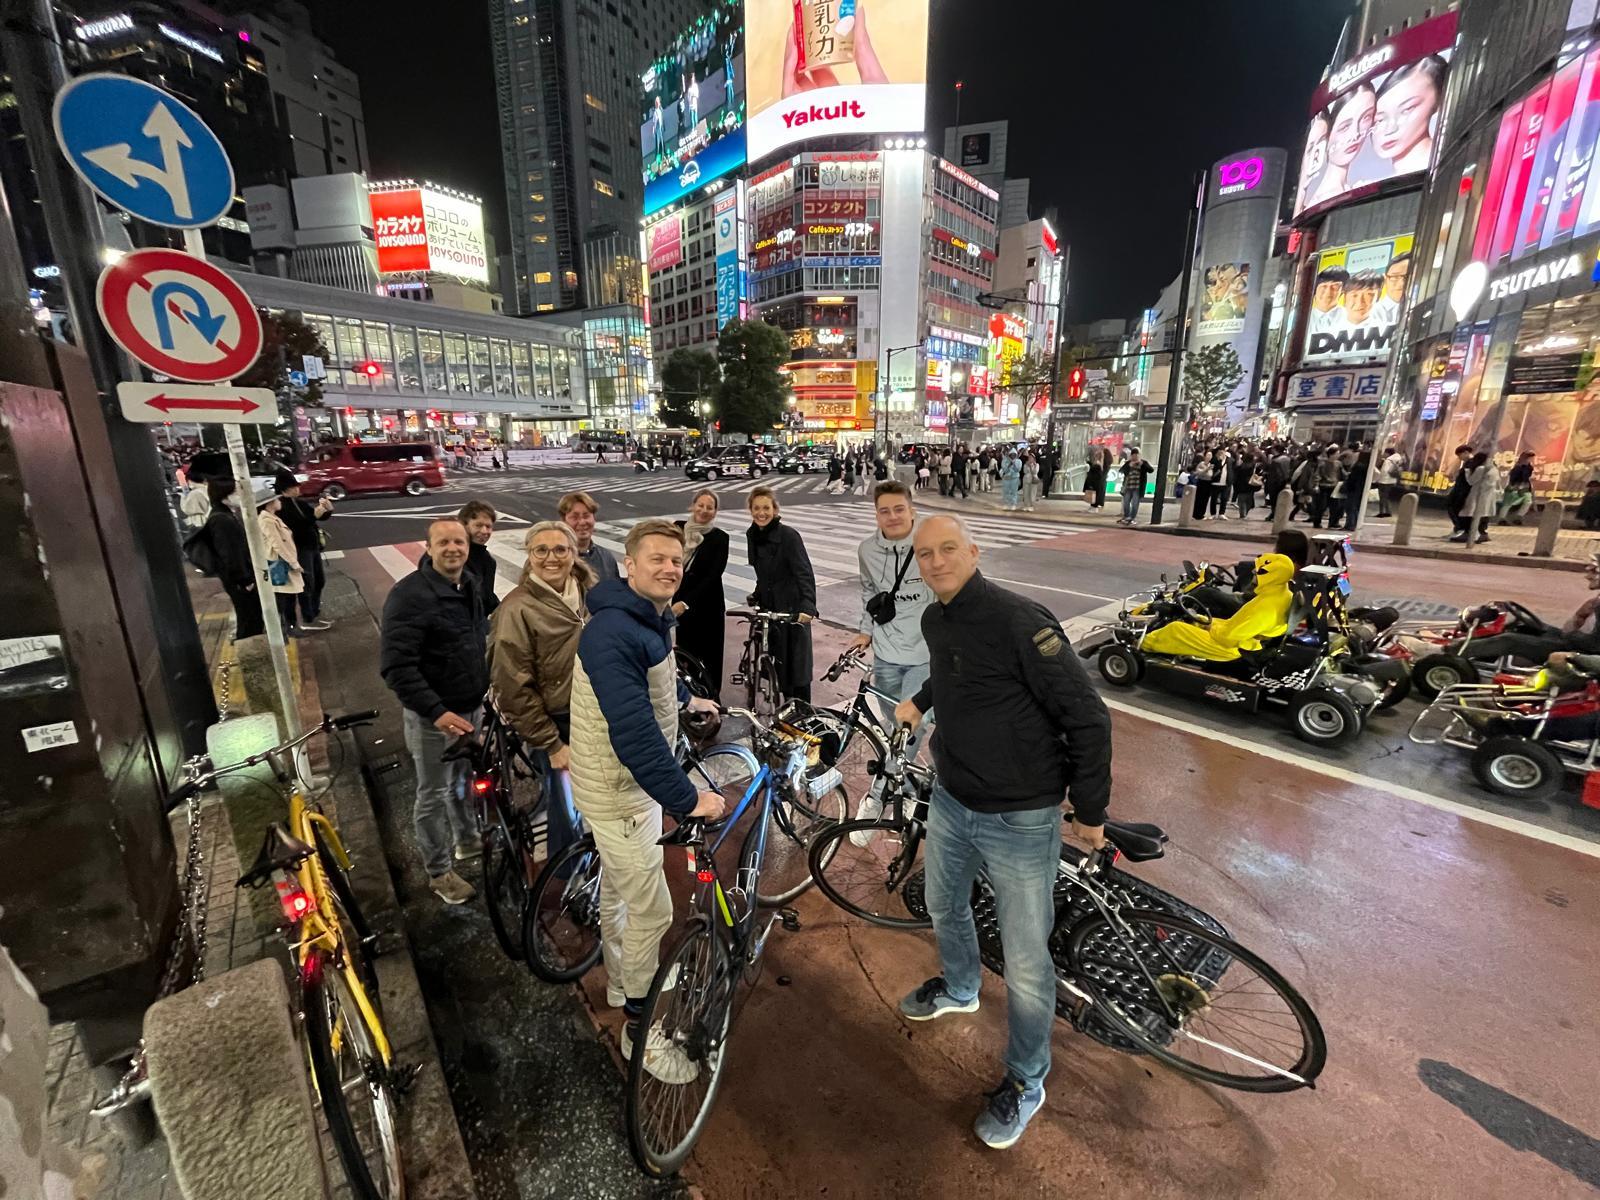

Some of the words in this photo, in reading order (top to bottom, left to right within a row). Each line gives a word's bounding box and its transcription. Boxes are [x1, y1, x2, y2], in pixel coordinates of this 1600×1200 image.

[1328, 45, 1394, 93] Rakuten
[782, 100, 865, 128] Yakult
[1219, 157, 1264, 189] 109
[426, 205, 468, 227] ココロの
[805, 202, 864, 214] コンタクト
[376, 215, 422, 235] カラオケ
[845, 222, 874, 236] ガスト
[379, 234, 426, 247] JOYSOUND
[430, 246, 484, 267] JOYSOUND
[1489, 253, 1582, 300] TSUTAYA
